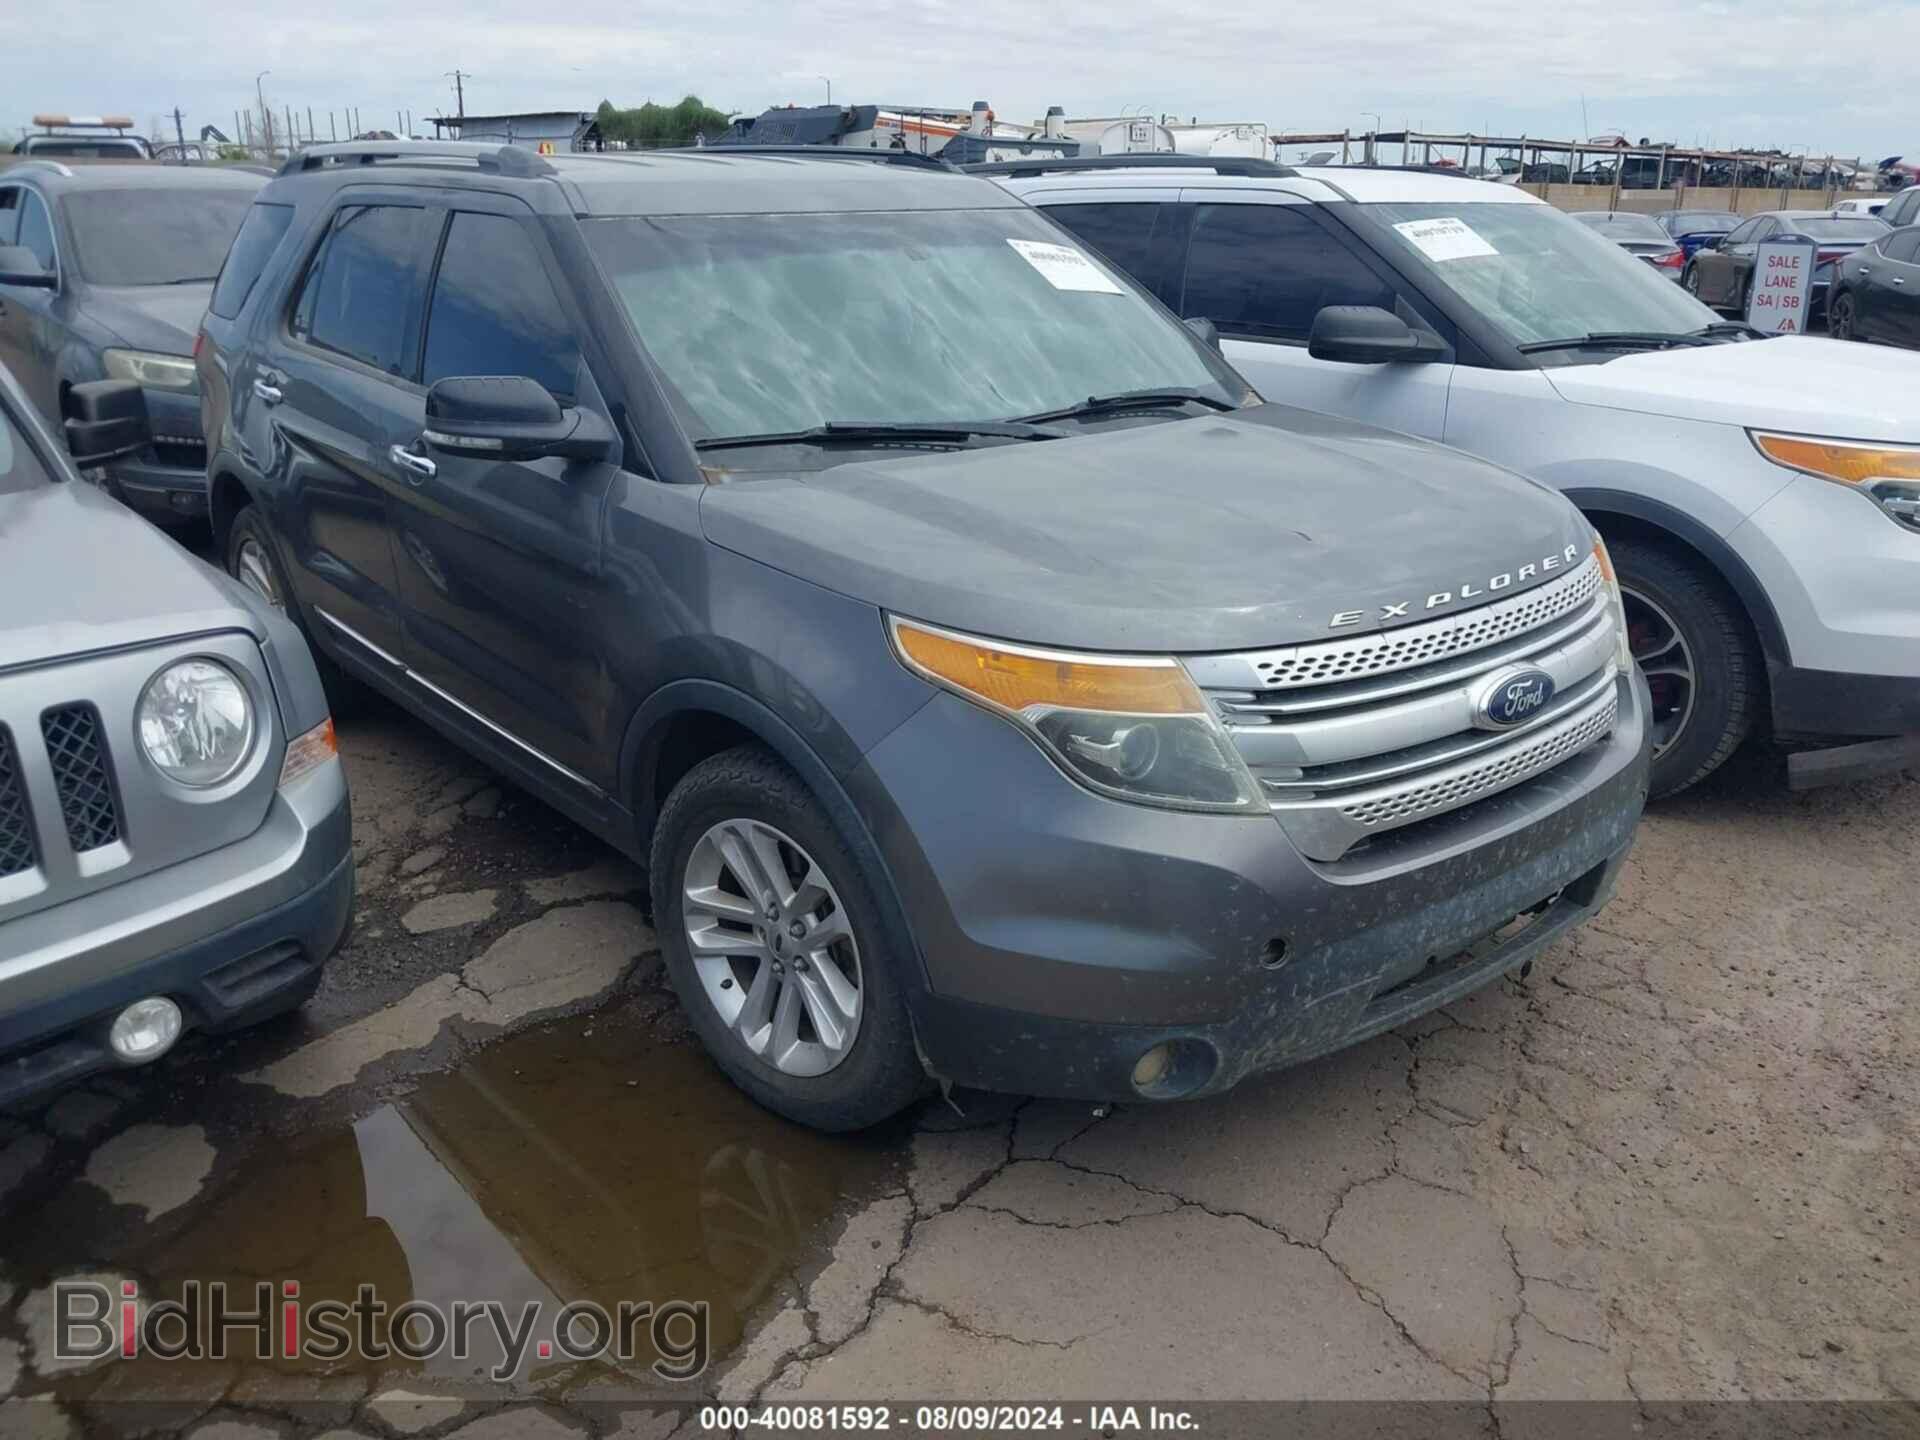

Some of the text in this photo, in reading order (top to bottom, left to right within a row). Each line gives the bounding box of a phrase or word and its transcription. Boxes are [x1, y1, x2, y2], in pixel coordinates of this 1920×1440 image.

[1768, 255, 1800, 269] SALE
[1765, 276, 1798, 289] LANE
[1756, 294, 1773, 307] SA
[1782, 295, 1800, 308] SB
[1328, 543, 1578, 628] EXPLORER
[1504, 679, 1544, 717] Ford
